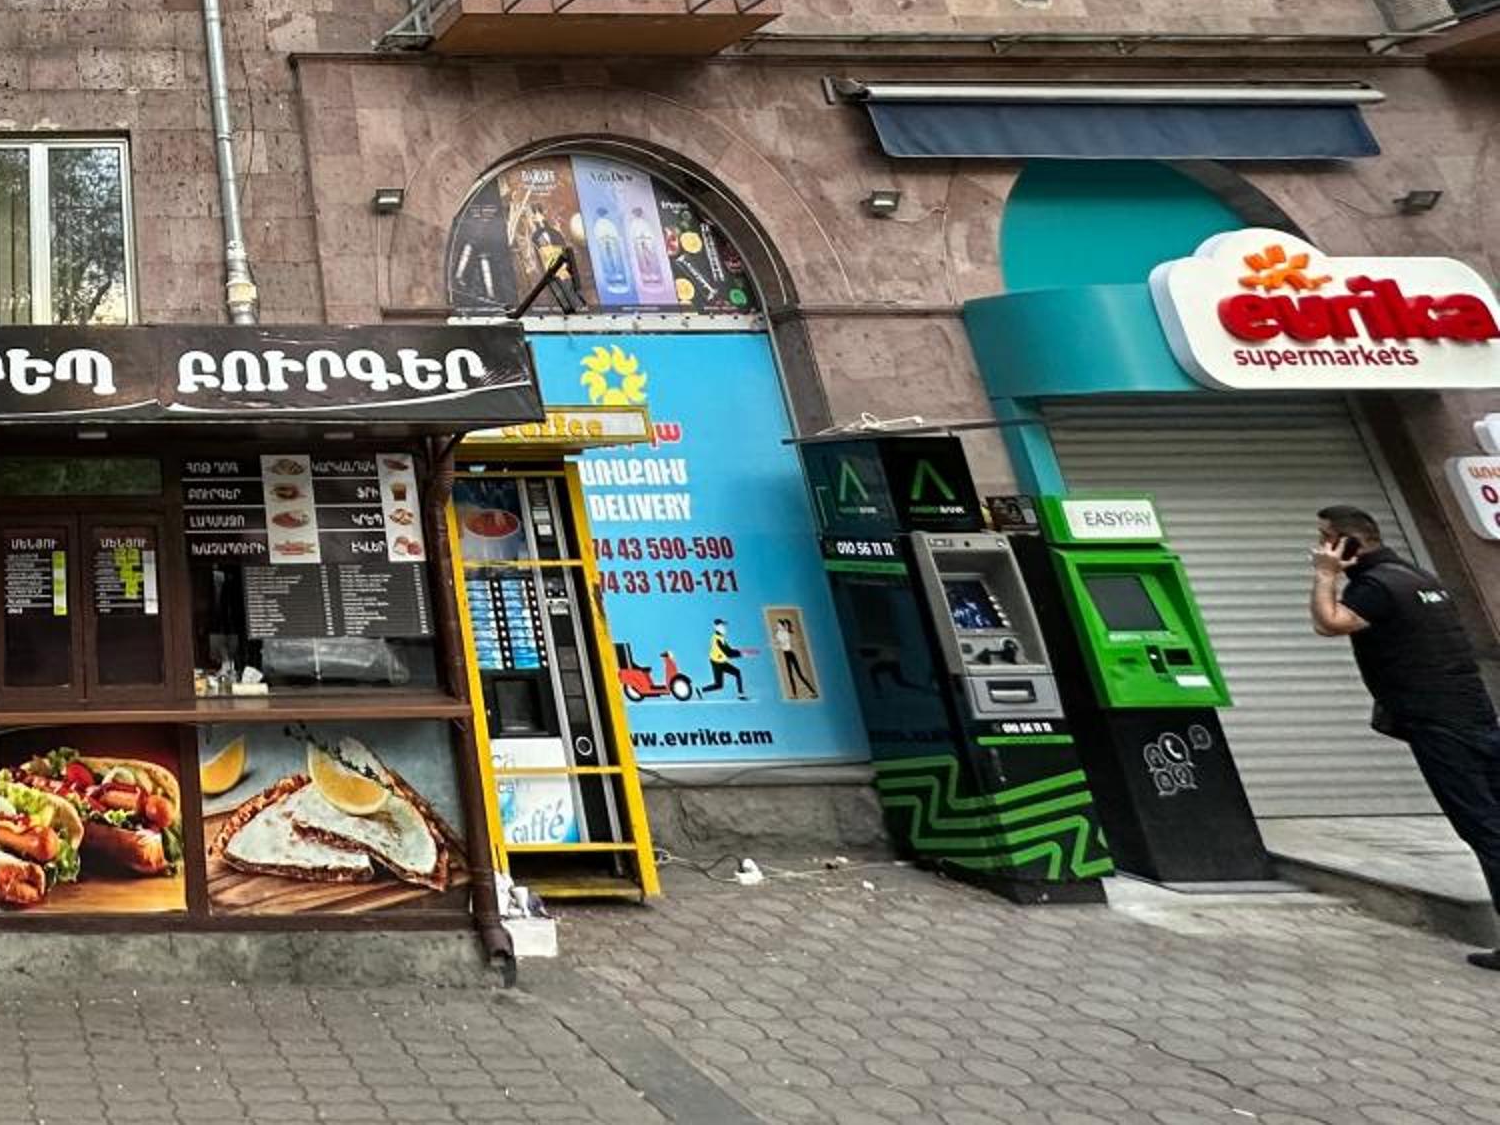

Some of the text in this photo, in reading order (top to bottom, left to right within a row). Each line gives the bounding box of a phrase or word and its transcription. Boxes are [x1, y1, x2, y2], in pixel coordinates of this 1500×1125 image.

[1217, 274, 1500, 343] evrika
[177, 346, 486, 394] ԲՈՒՐԳԵՐ
[1233, 346, 1419, 371] supermarkets
[589, 492, 692, 522] DELIVERY
[1083, 511, 1153, 527] EASYPAY
[617, 537, 643, 560] 43
[646, 535, 735, 560] 590-590
[835, 541, 895, 556] 010 56 11 11
[623, 570, 651, 593] 33
[654, 569, 740, 594] 120-121
